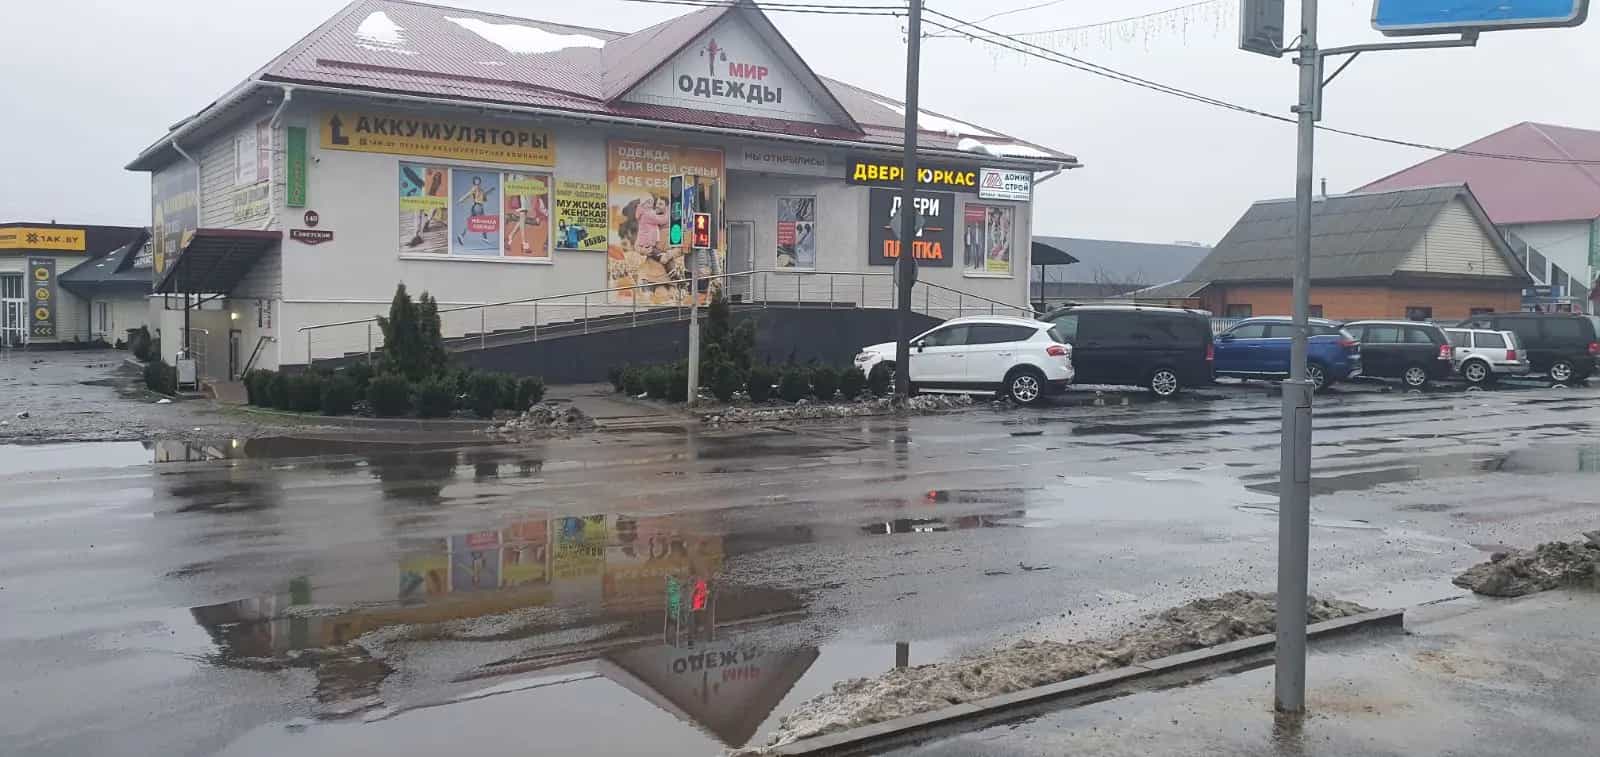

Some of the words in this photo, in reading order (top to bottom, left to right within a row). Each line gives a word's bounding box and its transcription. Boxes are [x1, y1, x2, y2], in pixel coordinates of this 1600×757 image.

[729, 62, 768, 80] МИР
[678, 75, 782, 104] ОДЕЖДЫ
[355, 116, 548, 149] АККУМУЛЯТОРЫ
[618, 147, 670, 161] ОДЕЖДА
[618, 160, 643, 171] ДЛЯ
[646, 162, 676, 173] ВСЕЙ
[679, 166, 718, 177] СЕМЬИ
[618, 175, 641, 186] ВСЕ
[1004, 183, 1028, 191] СТРОЙ
[556, 199, 607, 210] МУЖСКАЯ
[891, 196, 940, 217] ДЕРИ
[561, 208, 607, 218] ЖЕНСКАЯ
